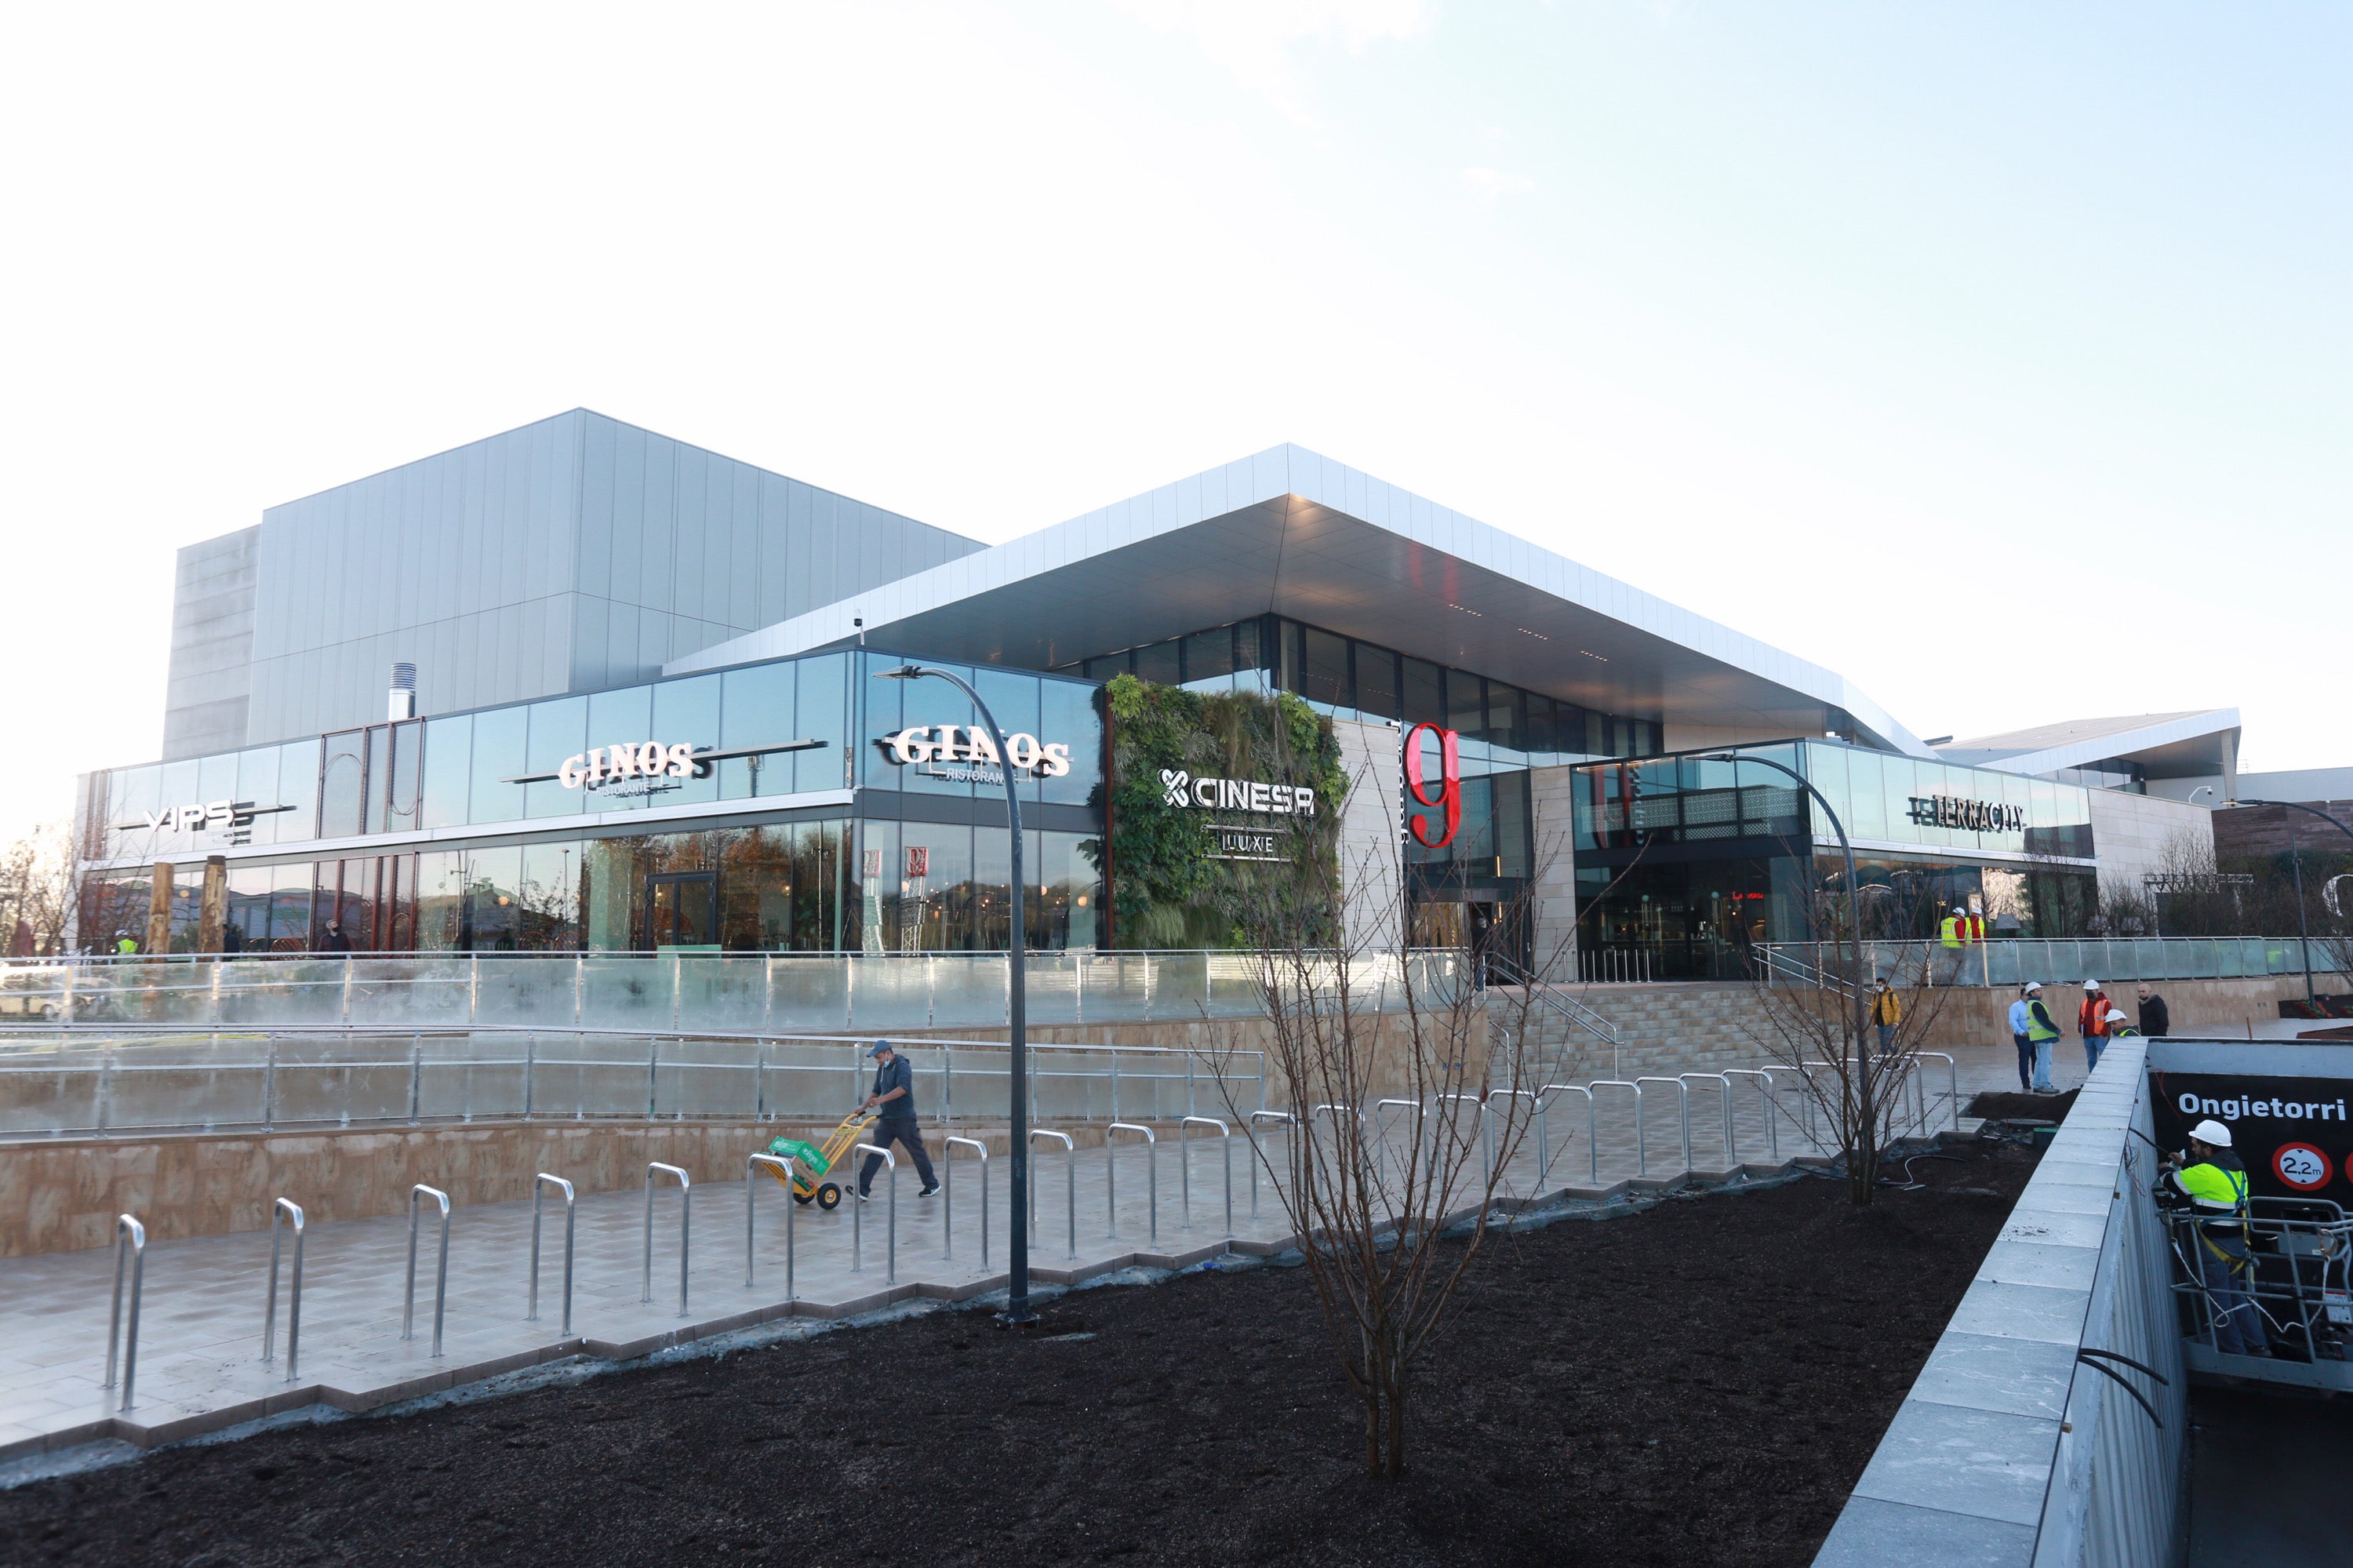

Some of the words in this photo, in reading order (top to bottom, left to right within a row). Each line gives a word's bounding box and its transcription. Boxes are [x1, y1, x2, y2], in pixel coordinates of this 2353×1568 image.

[558, 741, 693, 788] GINOS
[893, 725, 1070, 777] GINOS
[596, 782, 650, 796] RISTORANTE
[946, 768, 1017, 783] RISTORAN
[1191, 777, 1315, 816] CINESA
[143, 799, 235, 831] VIPS
[1933, 795, 2024, 831] TERRACITY
[1224, 834, 1274, 852] LUXE
[2179, 1093, 2346, 1120] Ongietorri
